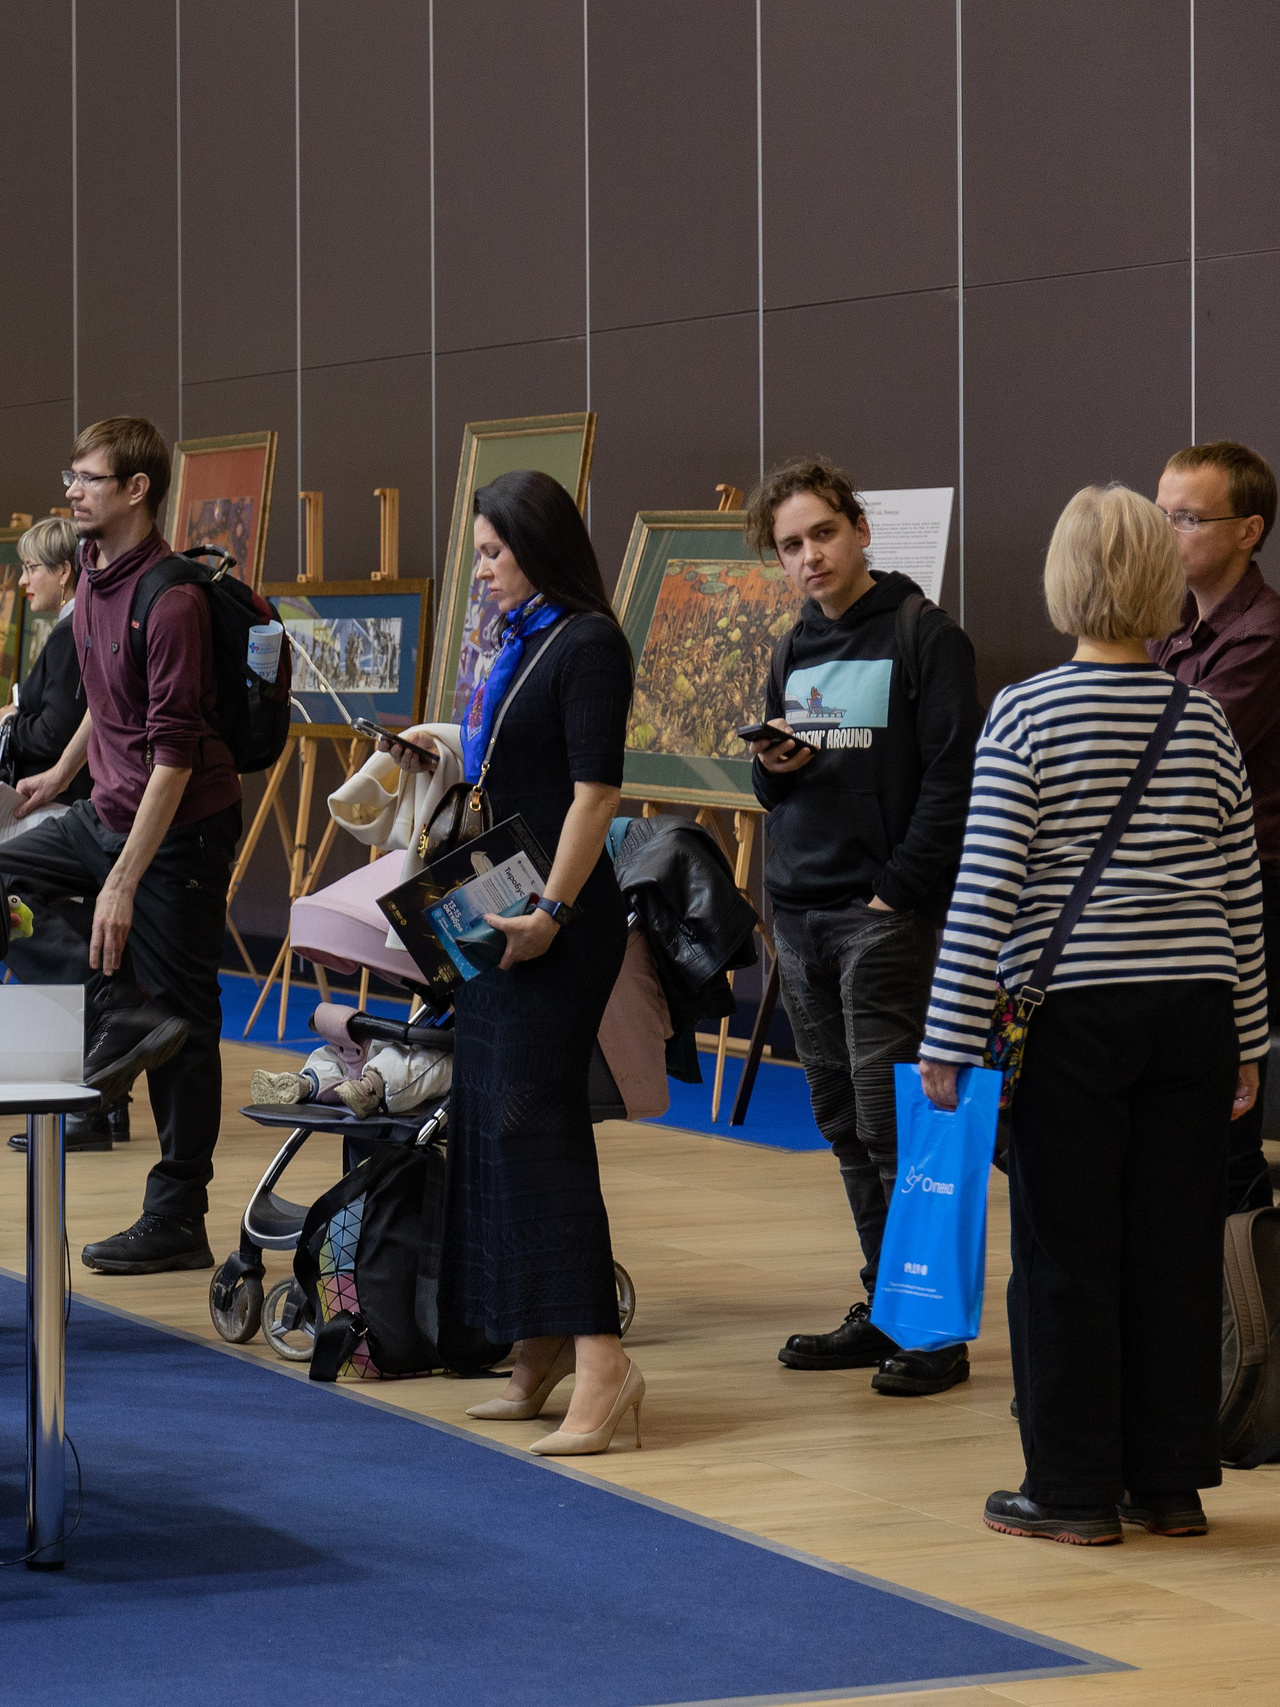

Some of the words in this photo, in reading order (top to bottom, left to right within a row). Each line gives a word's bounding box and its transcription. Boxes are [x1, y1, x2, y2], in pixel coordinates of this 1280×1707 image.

[826, 728, 873, 749] AROUND
[442, 904, 464, 933] октября
[921, 1176, 955, 1195] Опека
